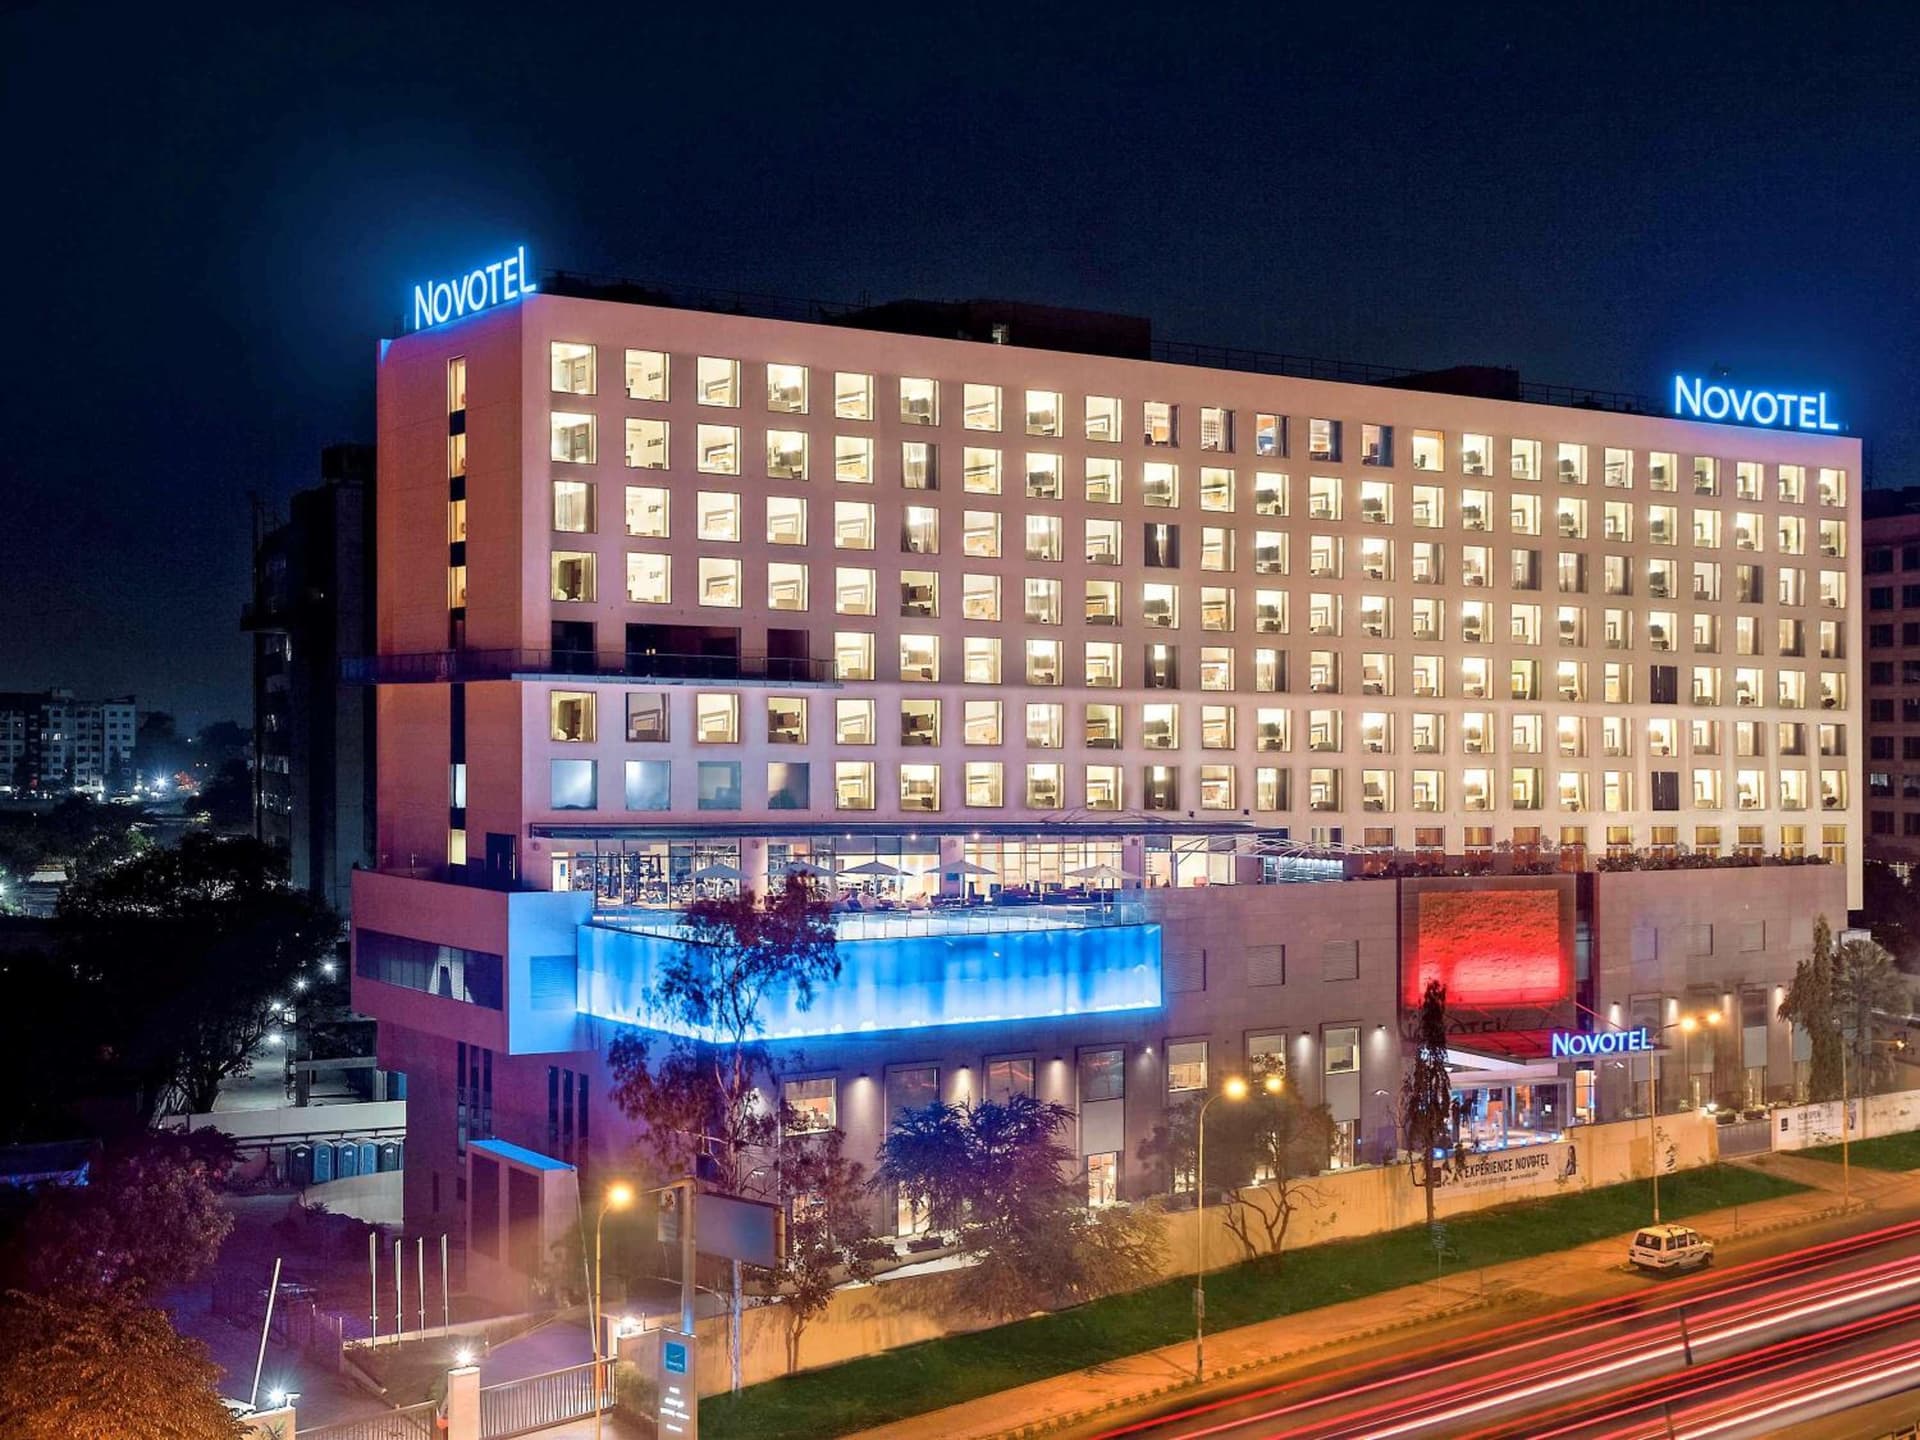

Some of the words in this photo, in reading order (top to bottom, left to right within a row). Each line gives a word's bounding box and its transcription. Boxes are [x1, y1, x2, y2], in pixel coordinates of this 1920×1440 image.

[415, 246, 536, 329] NOVOTEL
[1675, 375, 1839, 430] NOVOTEL
[1552, 1028, 1654, 1057] NOVOTEL
[1465, 1158, 1513, 1179] EXPERIENCE
[1515, 1153, 1550, 1170] NOVOTEL
